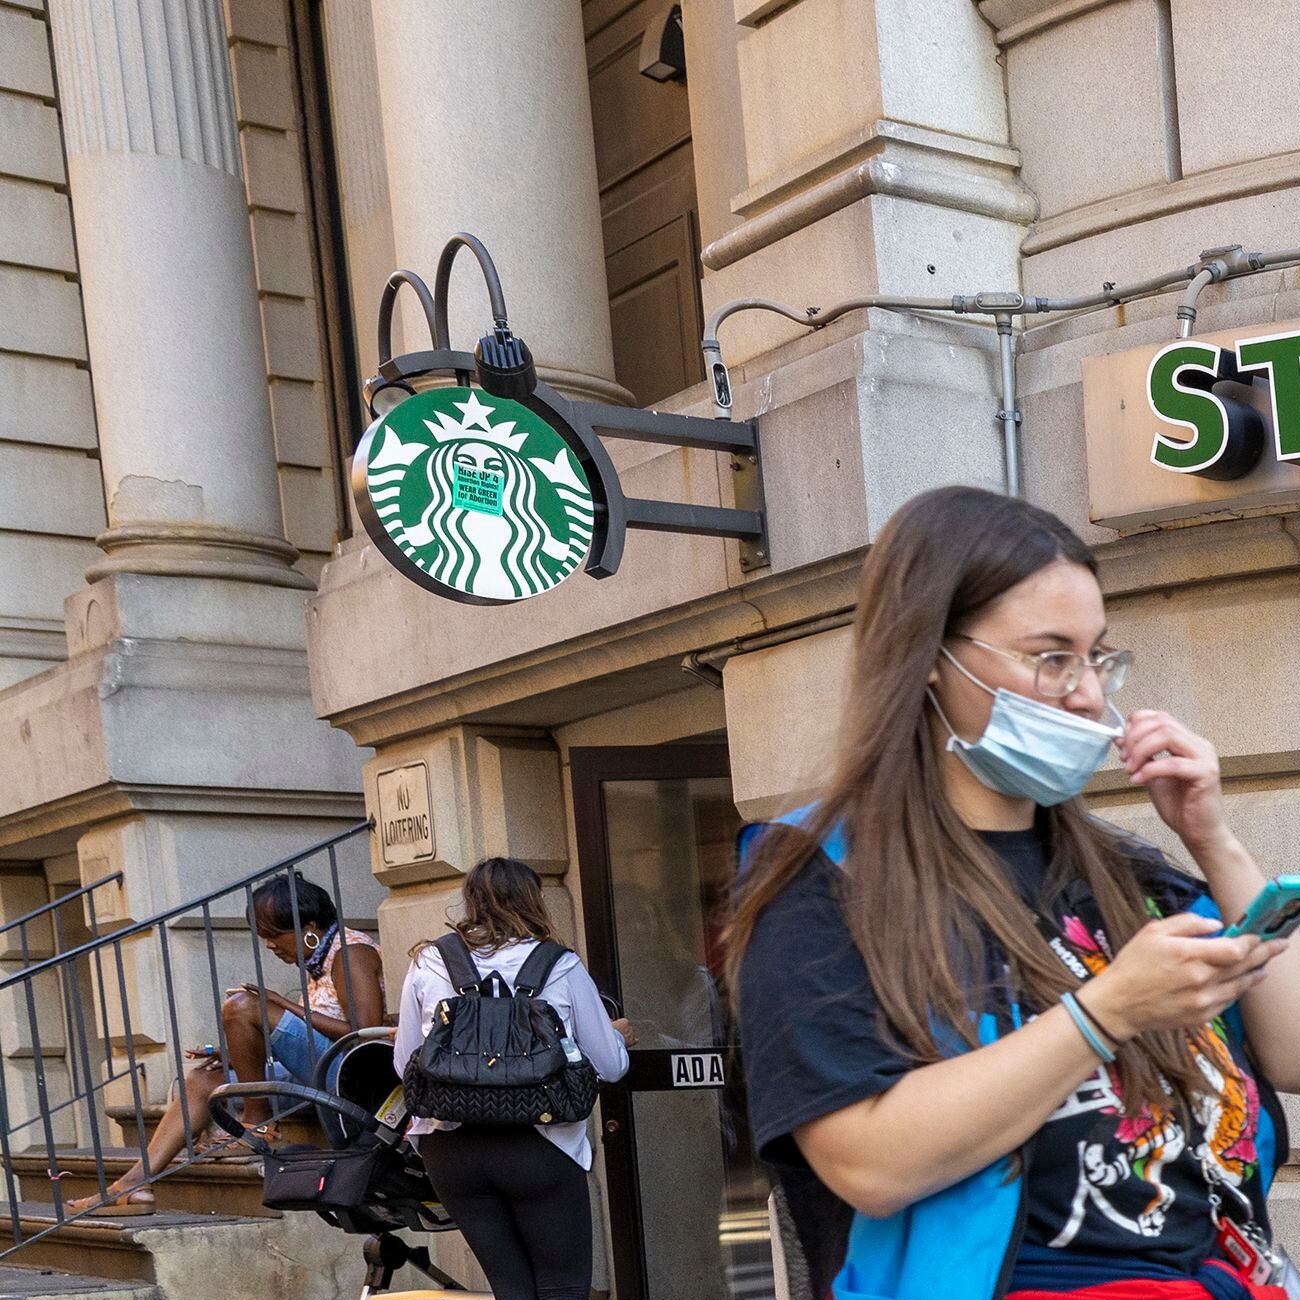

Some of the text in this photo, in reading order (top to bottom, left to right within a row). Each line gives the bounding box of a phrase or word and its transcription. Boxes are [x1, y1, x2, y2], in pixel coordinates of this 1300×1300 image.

[458, 491, 498, 506] for Abortion
[459, 483, 498, 499] WEAR GREEN
[397, 783, 410, 811] NO
[384, 814, 429, 847] LOITERING
[676, 1056, 724, 1083] ADA
